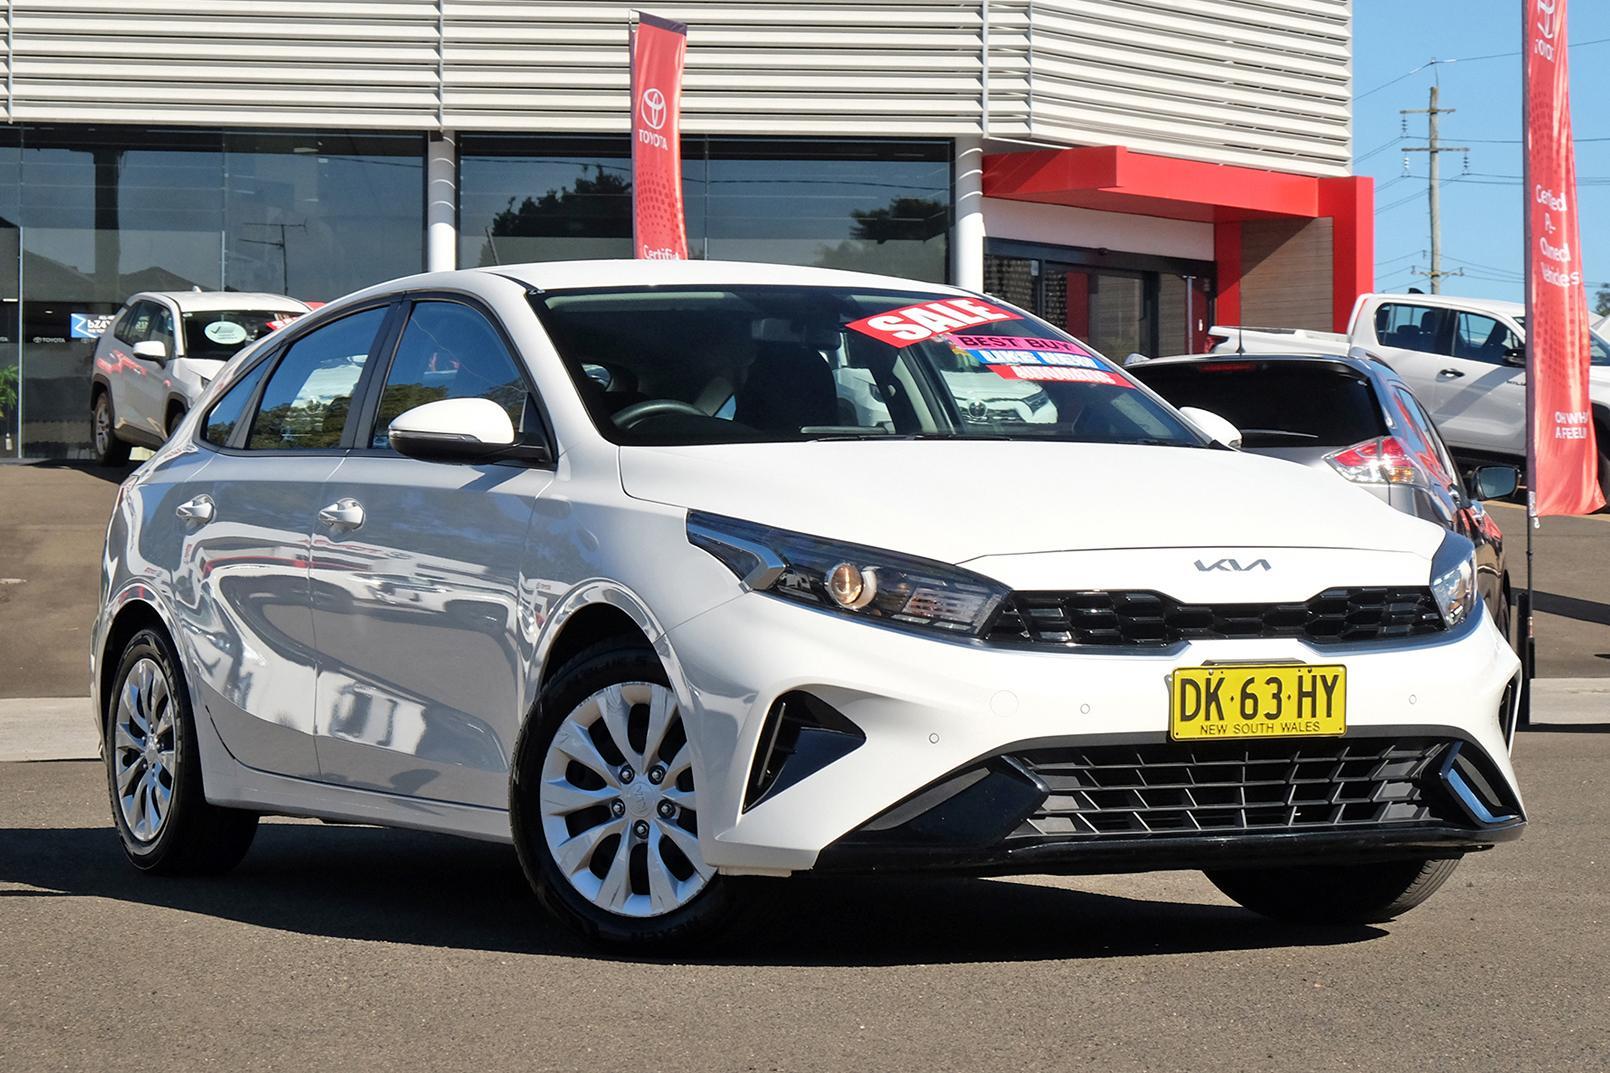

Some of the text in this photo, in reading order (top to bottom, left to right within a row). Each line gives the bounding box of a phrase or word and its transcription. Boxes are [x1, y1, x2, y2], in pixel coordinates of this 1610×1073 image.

[638, 129, 668, 151] TOYOTA
[866, 298, 1010, 341] SALE
[957, 336, 1073, 351] BEST BUY
[978, 350, 1100, 369] LIKE NEW
[1193, 558, 1272, 572] KIA
[1199, 721, 1321, 735] NEW SOUTH WALES
